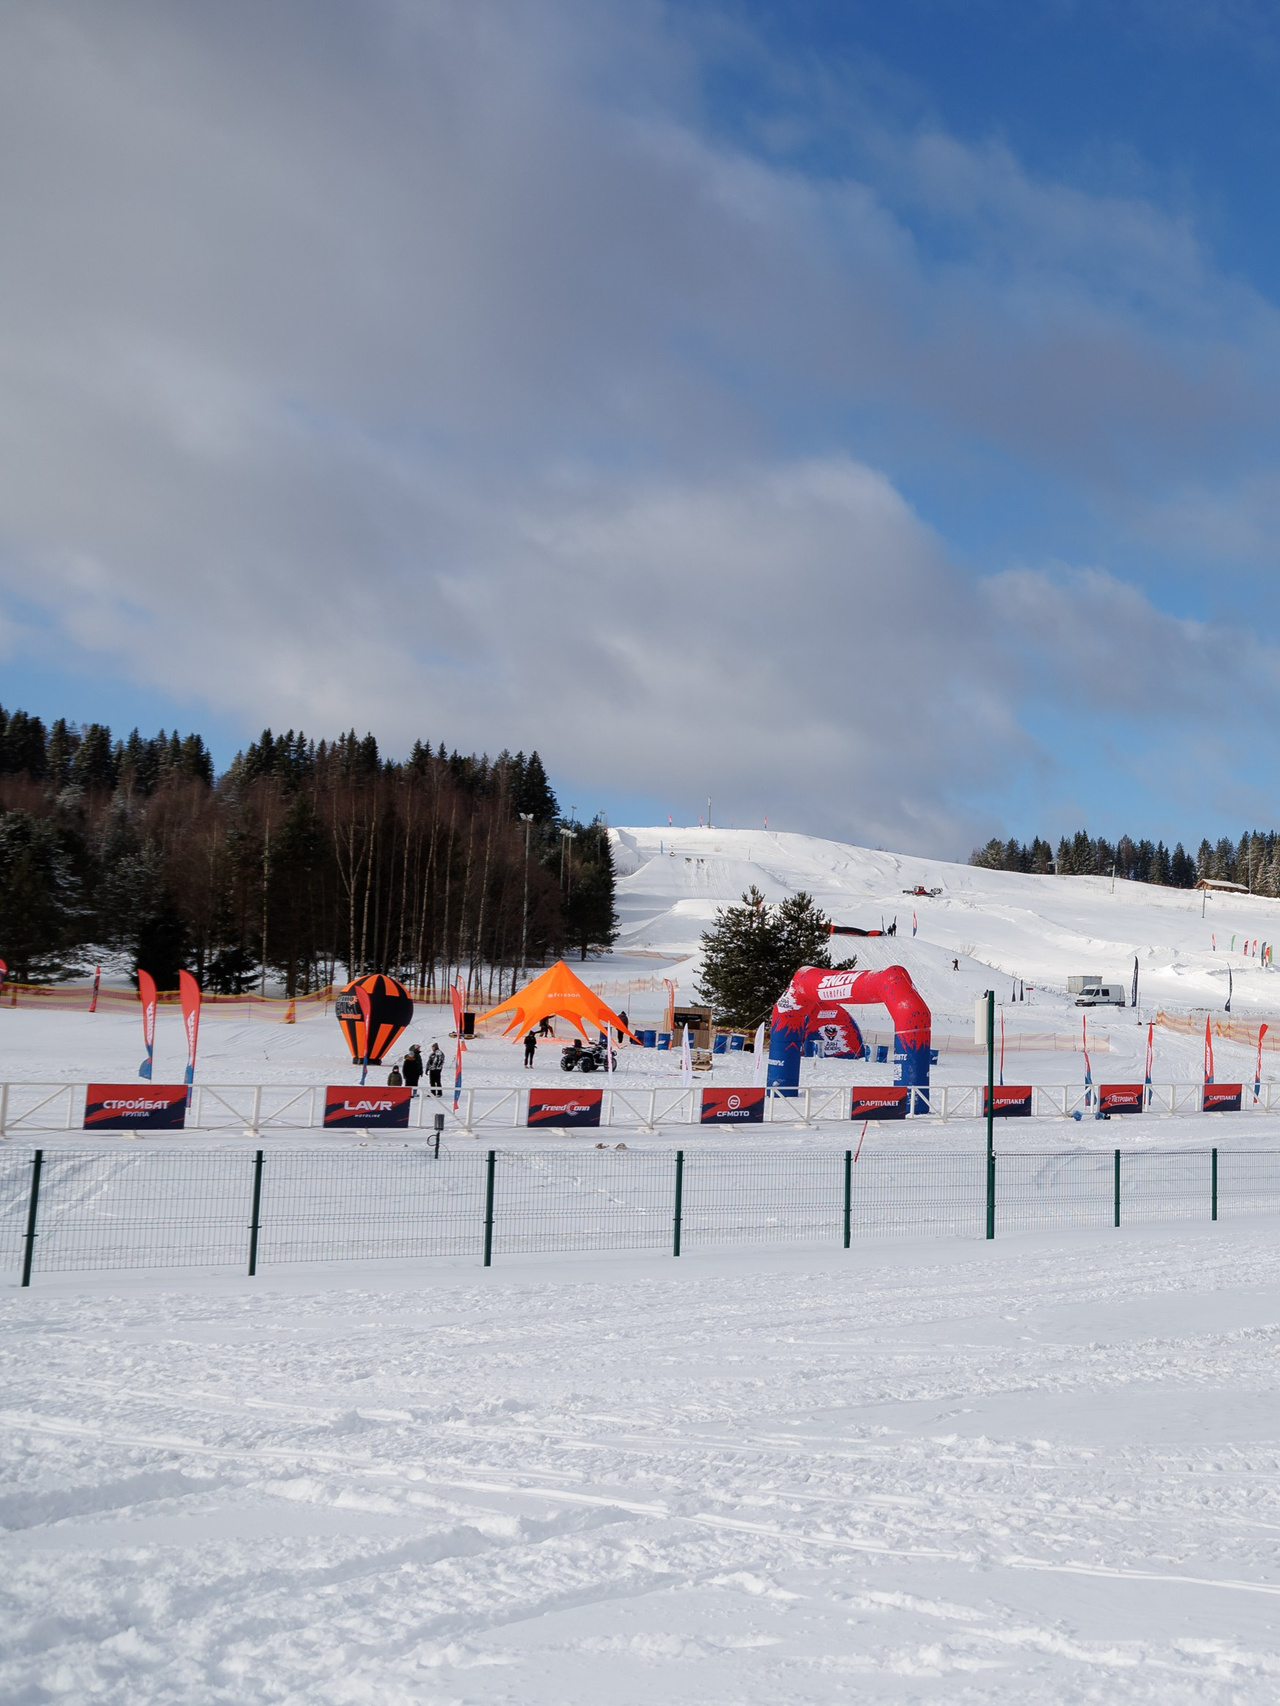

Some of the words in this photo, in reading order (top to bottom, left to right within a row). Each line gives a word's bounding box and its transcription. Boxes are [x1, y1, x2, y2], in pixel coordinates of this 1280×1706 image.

[818, 971, 864, 988] SNOW
[103, 1097, 169, 1110] СТРОЙБАТ
[344, 1100, 393, 1111] LAVR
[541, 1100, 591, 1116] FreedConn
